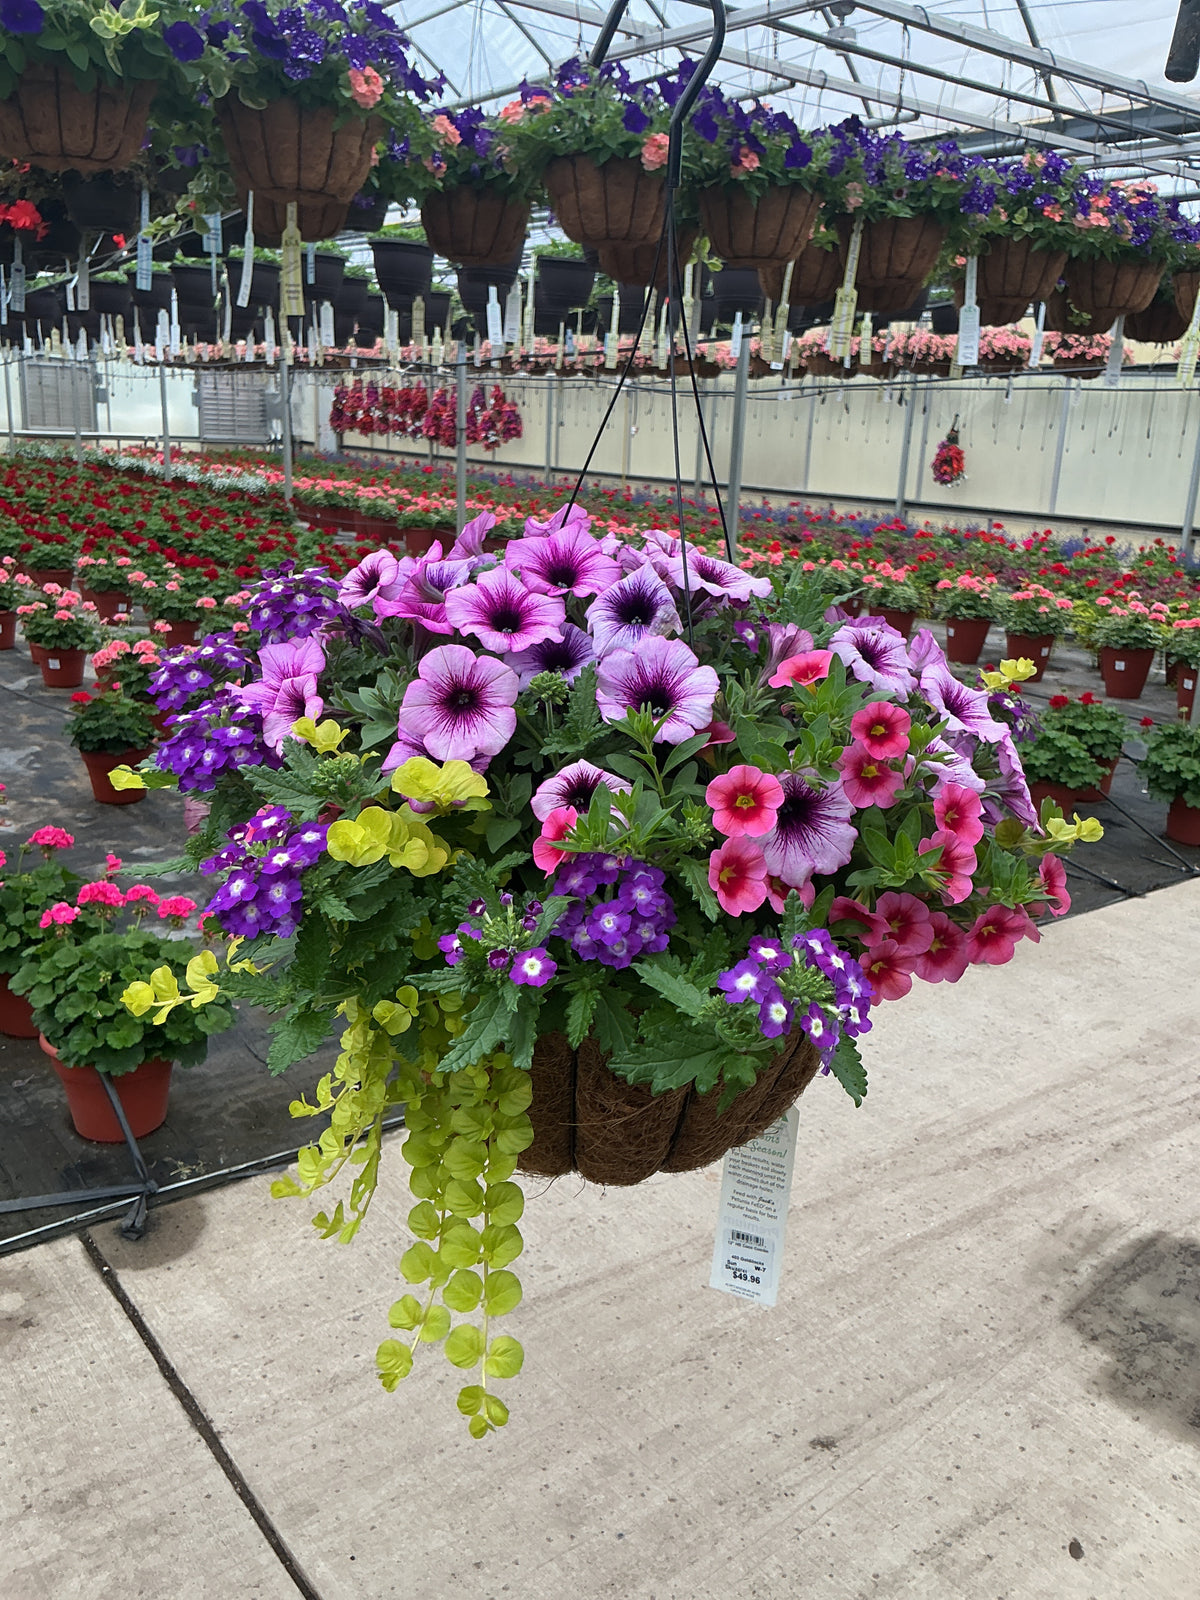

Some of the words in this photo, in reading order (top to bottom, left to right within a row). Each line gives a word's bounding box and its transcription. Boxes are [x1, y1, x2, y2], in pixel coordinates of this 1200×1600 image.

[742, 1167, 763, 1177] morning
[736, 1179, 758, 1189] drainage
[733, 1189, 745, 1197] Feed
[727, 1202, 744, 1210] regular
[766, 1212, 778, 1220] best
[733, 1271, 760, 1284] $49.96
